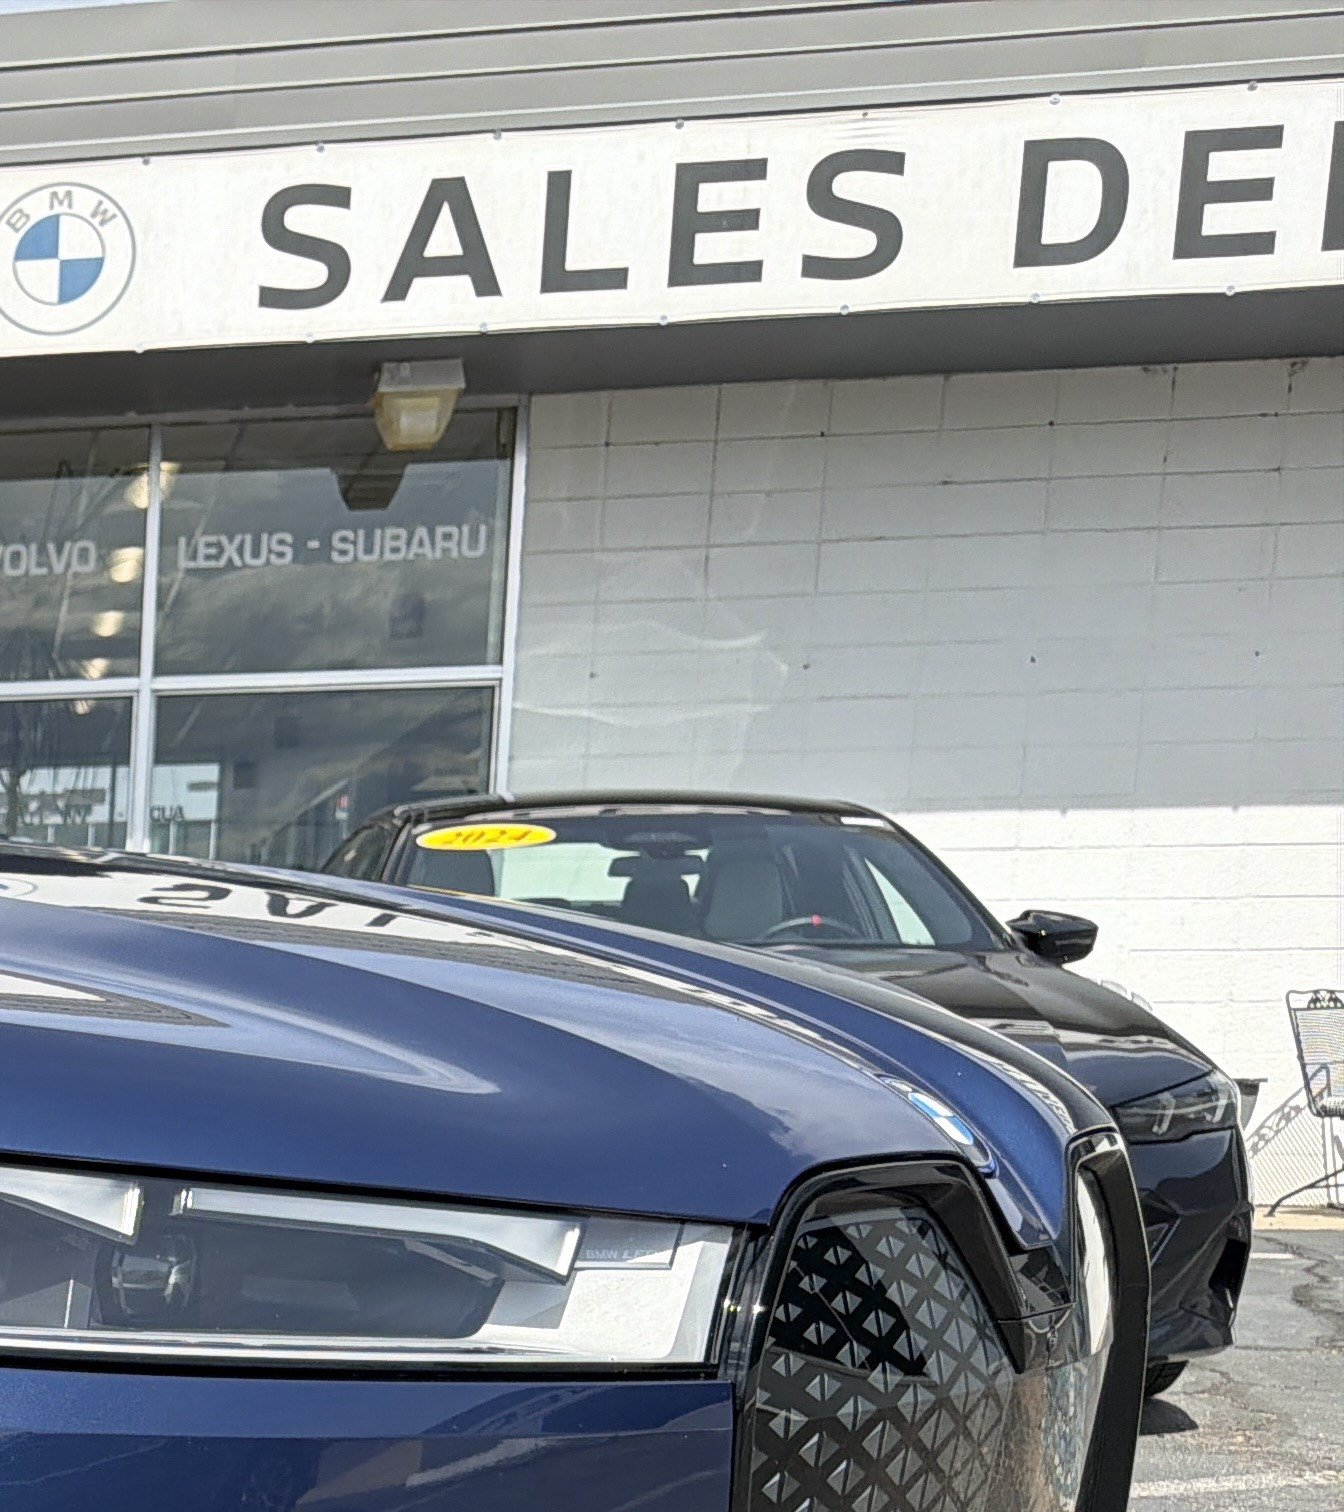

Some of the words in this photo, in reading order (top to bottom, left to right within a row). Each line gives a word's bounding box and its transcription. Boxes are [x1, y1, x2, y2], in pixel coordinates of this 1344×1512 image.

[257, 147, 907, 312] SALES
[1013, 120, 1344, 269] DE
[177, 531, 294, 569] LEXUS
[330, 524, 488, 564] SUBARU
